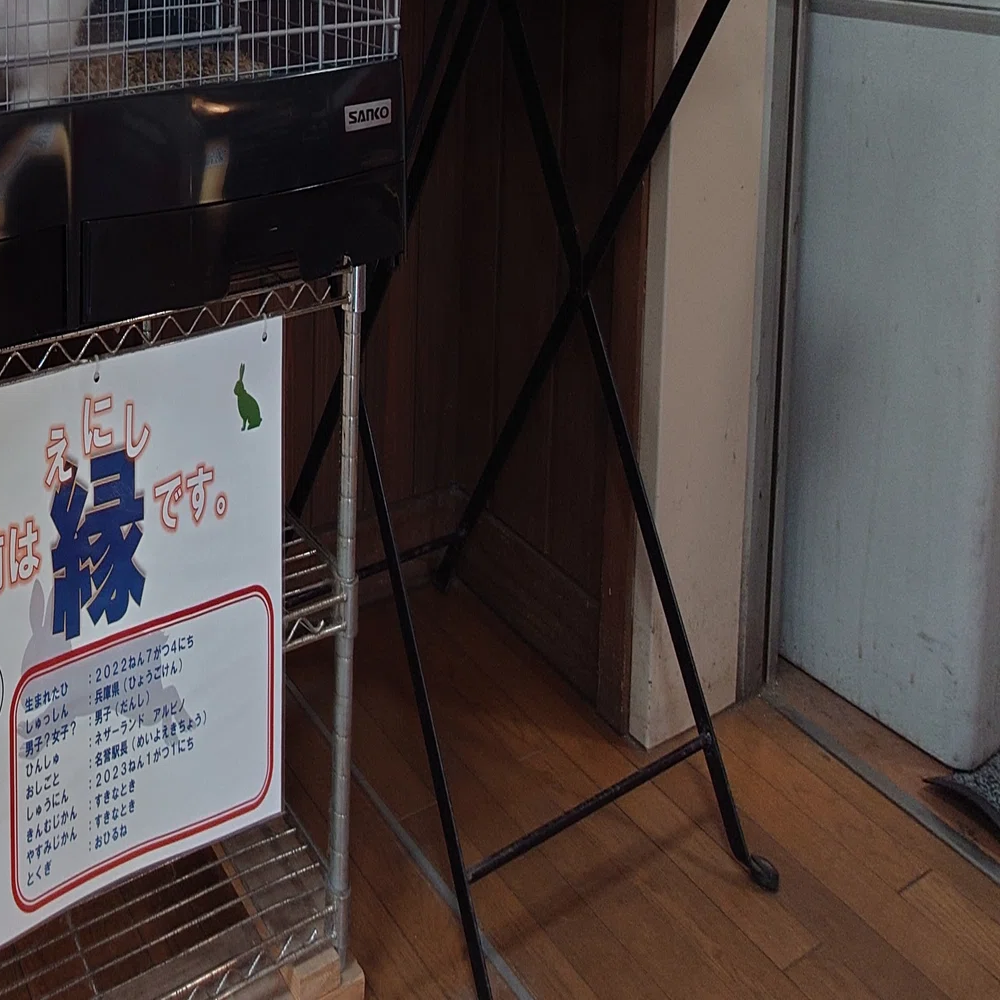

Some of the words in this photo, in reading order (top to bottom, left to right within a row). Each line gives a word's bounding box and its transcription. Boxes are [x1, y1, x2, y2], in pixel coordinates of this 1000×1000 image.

[349, 106, 389, 124] SANKO
[45, 395, 151, 489] えにし
[50, 449, 147, 641] 縁
[154, 463, 228, 531] です。
[25, 681, 68, 713] 生まれたひ
[26, 703, 69, 734] しゅっしん
[25, 720, 77, 758] 男子？女子？
[25, 753, 60, 778] ひんしゅ
[26, 772, 60, 800] おしごと
[26, 789, 69, 821] しゅうにん
[26, 805, 77, 843] きんむじかん
[26, 826, 77, 864] やすみじかん
[27, 859, 52, 886] とくぎ
